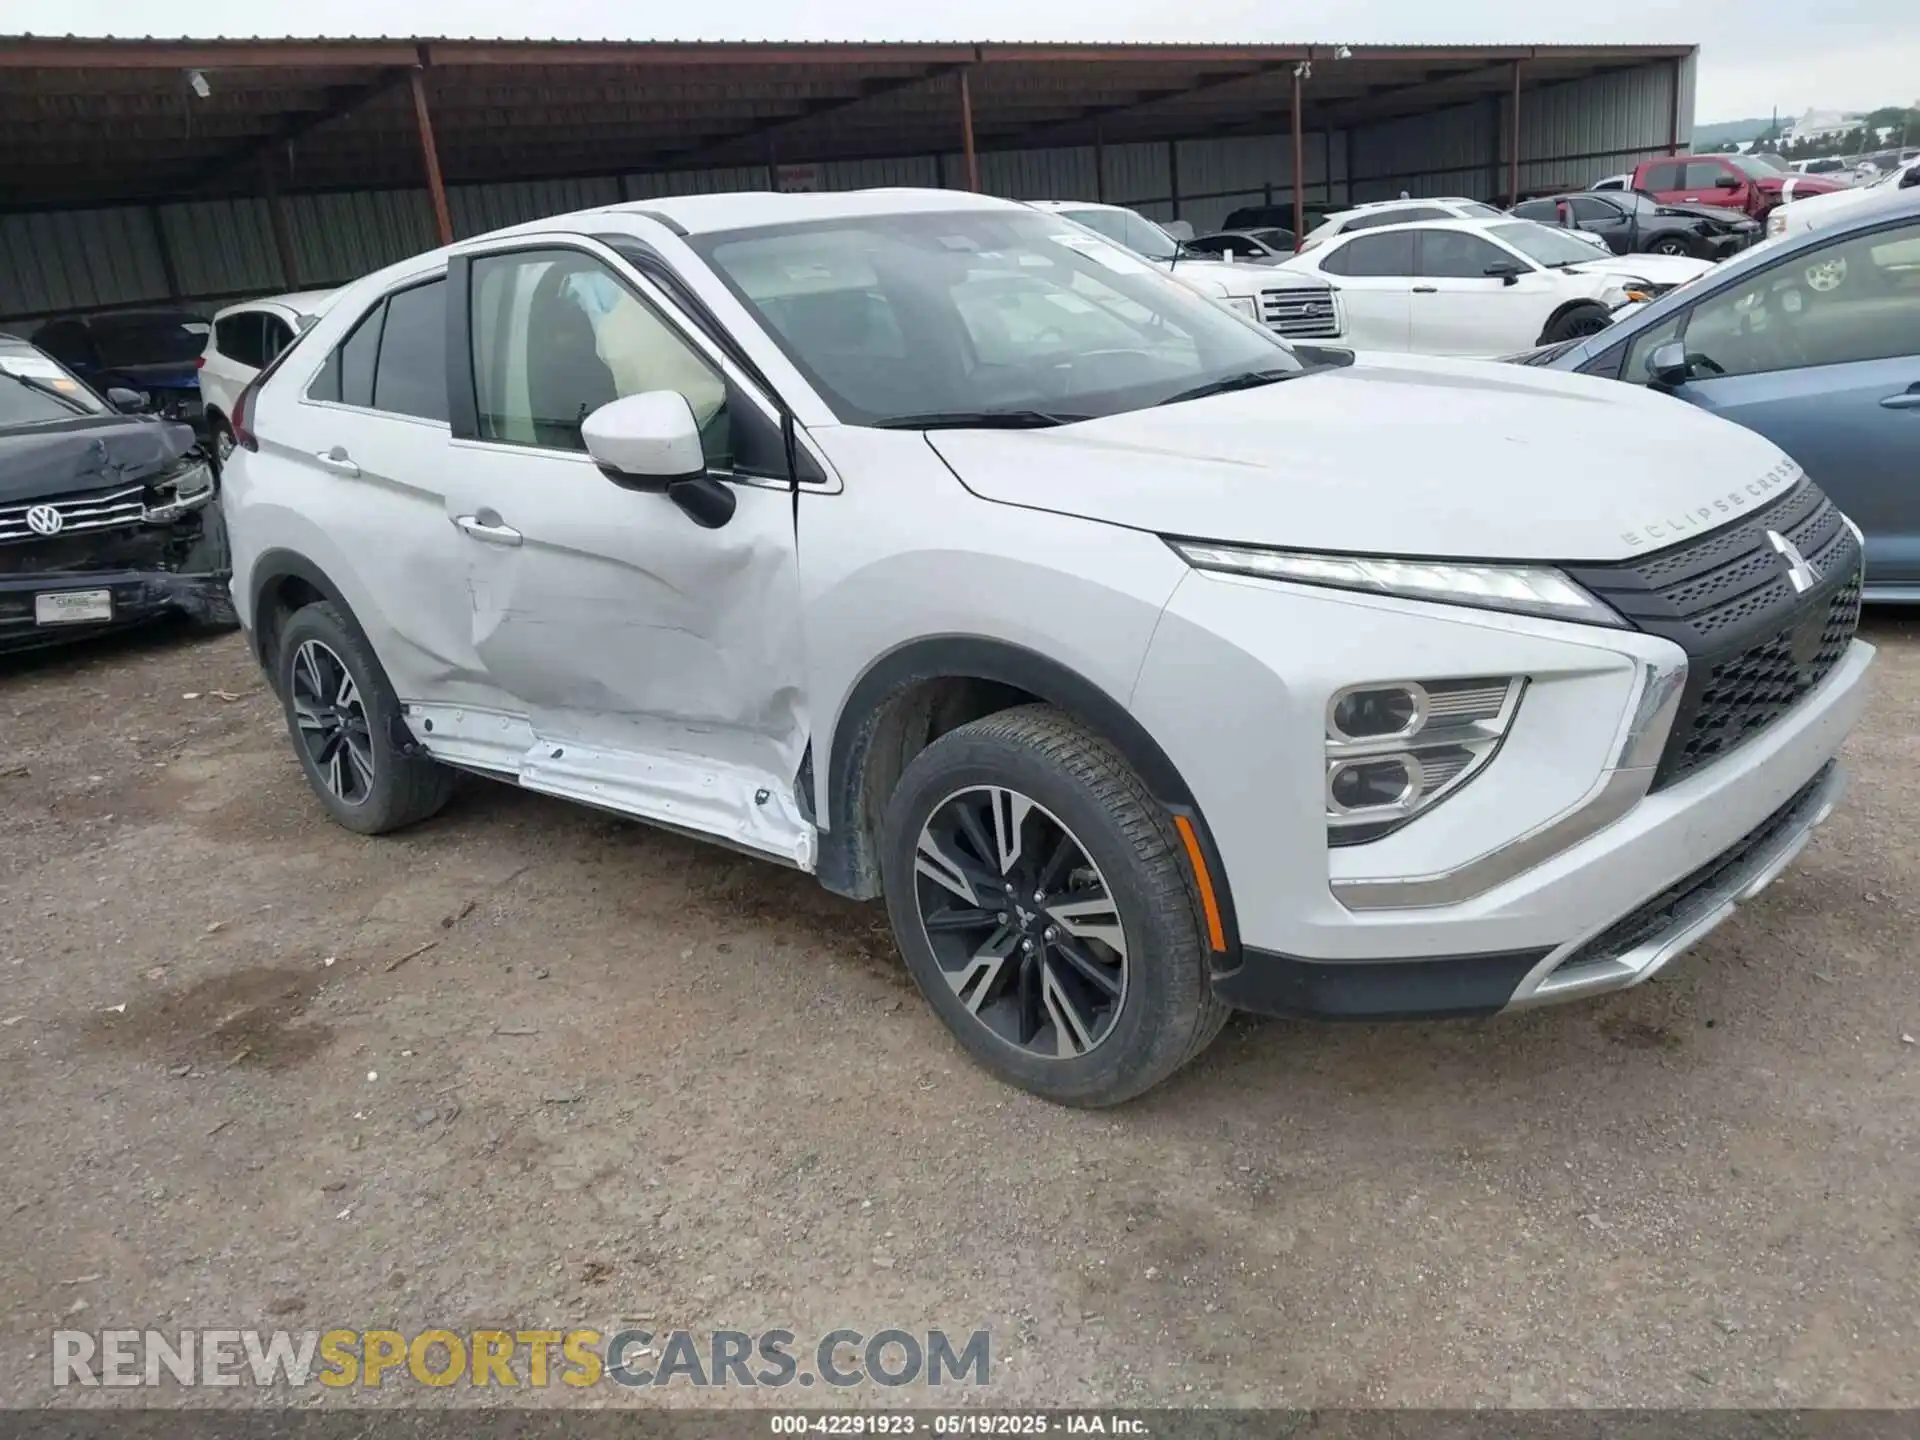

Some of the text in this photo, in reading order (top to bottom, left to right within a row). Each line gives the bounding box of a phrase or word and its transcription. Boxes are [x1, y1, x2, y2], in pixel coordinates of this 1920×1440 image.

[27, 505, 62, 535] VW
[1620, 459, 1794, 546] ECLIPSE CROSS
